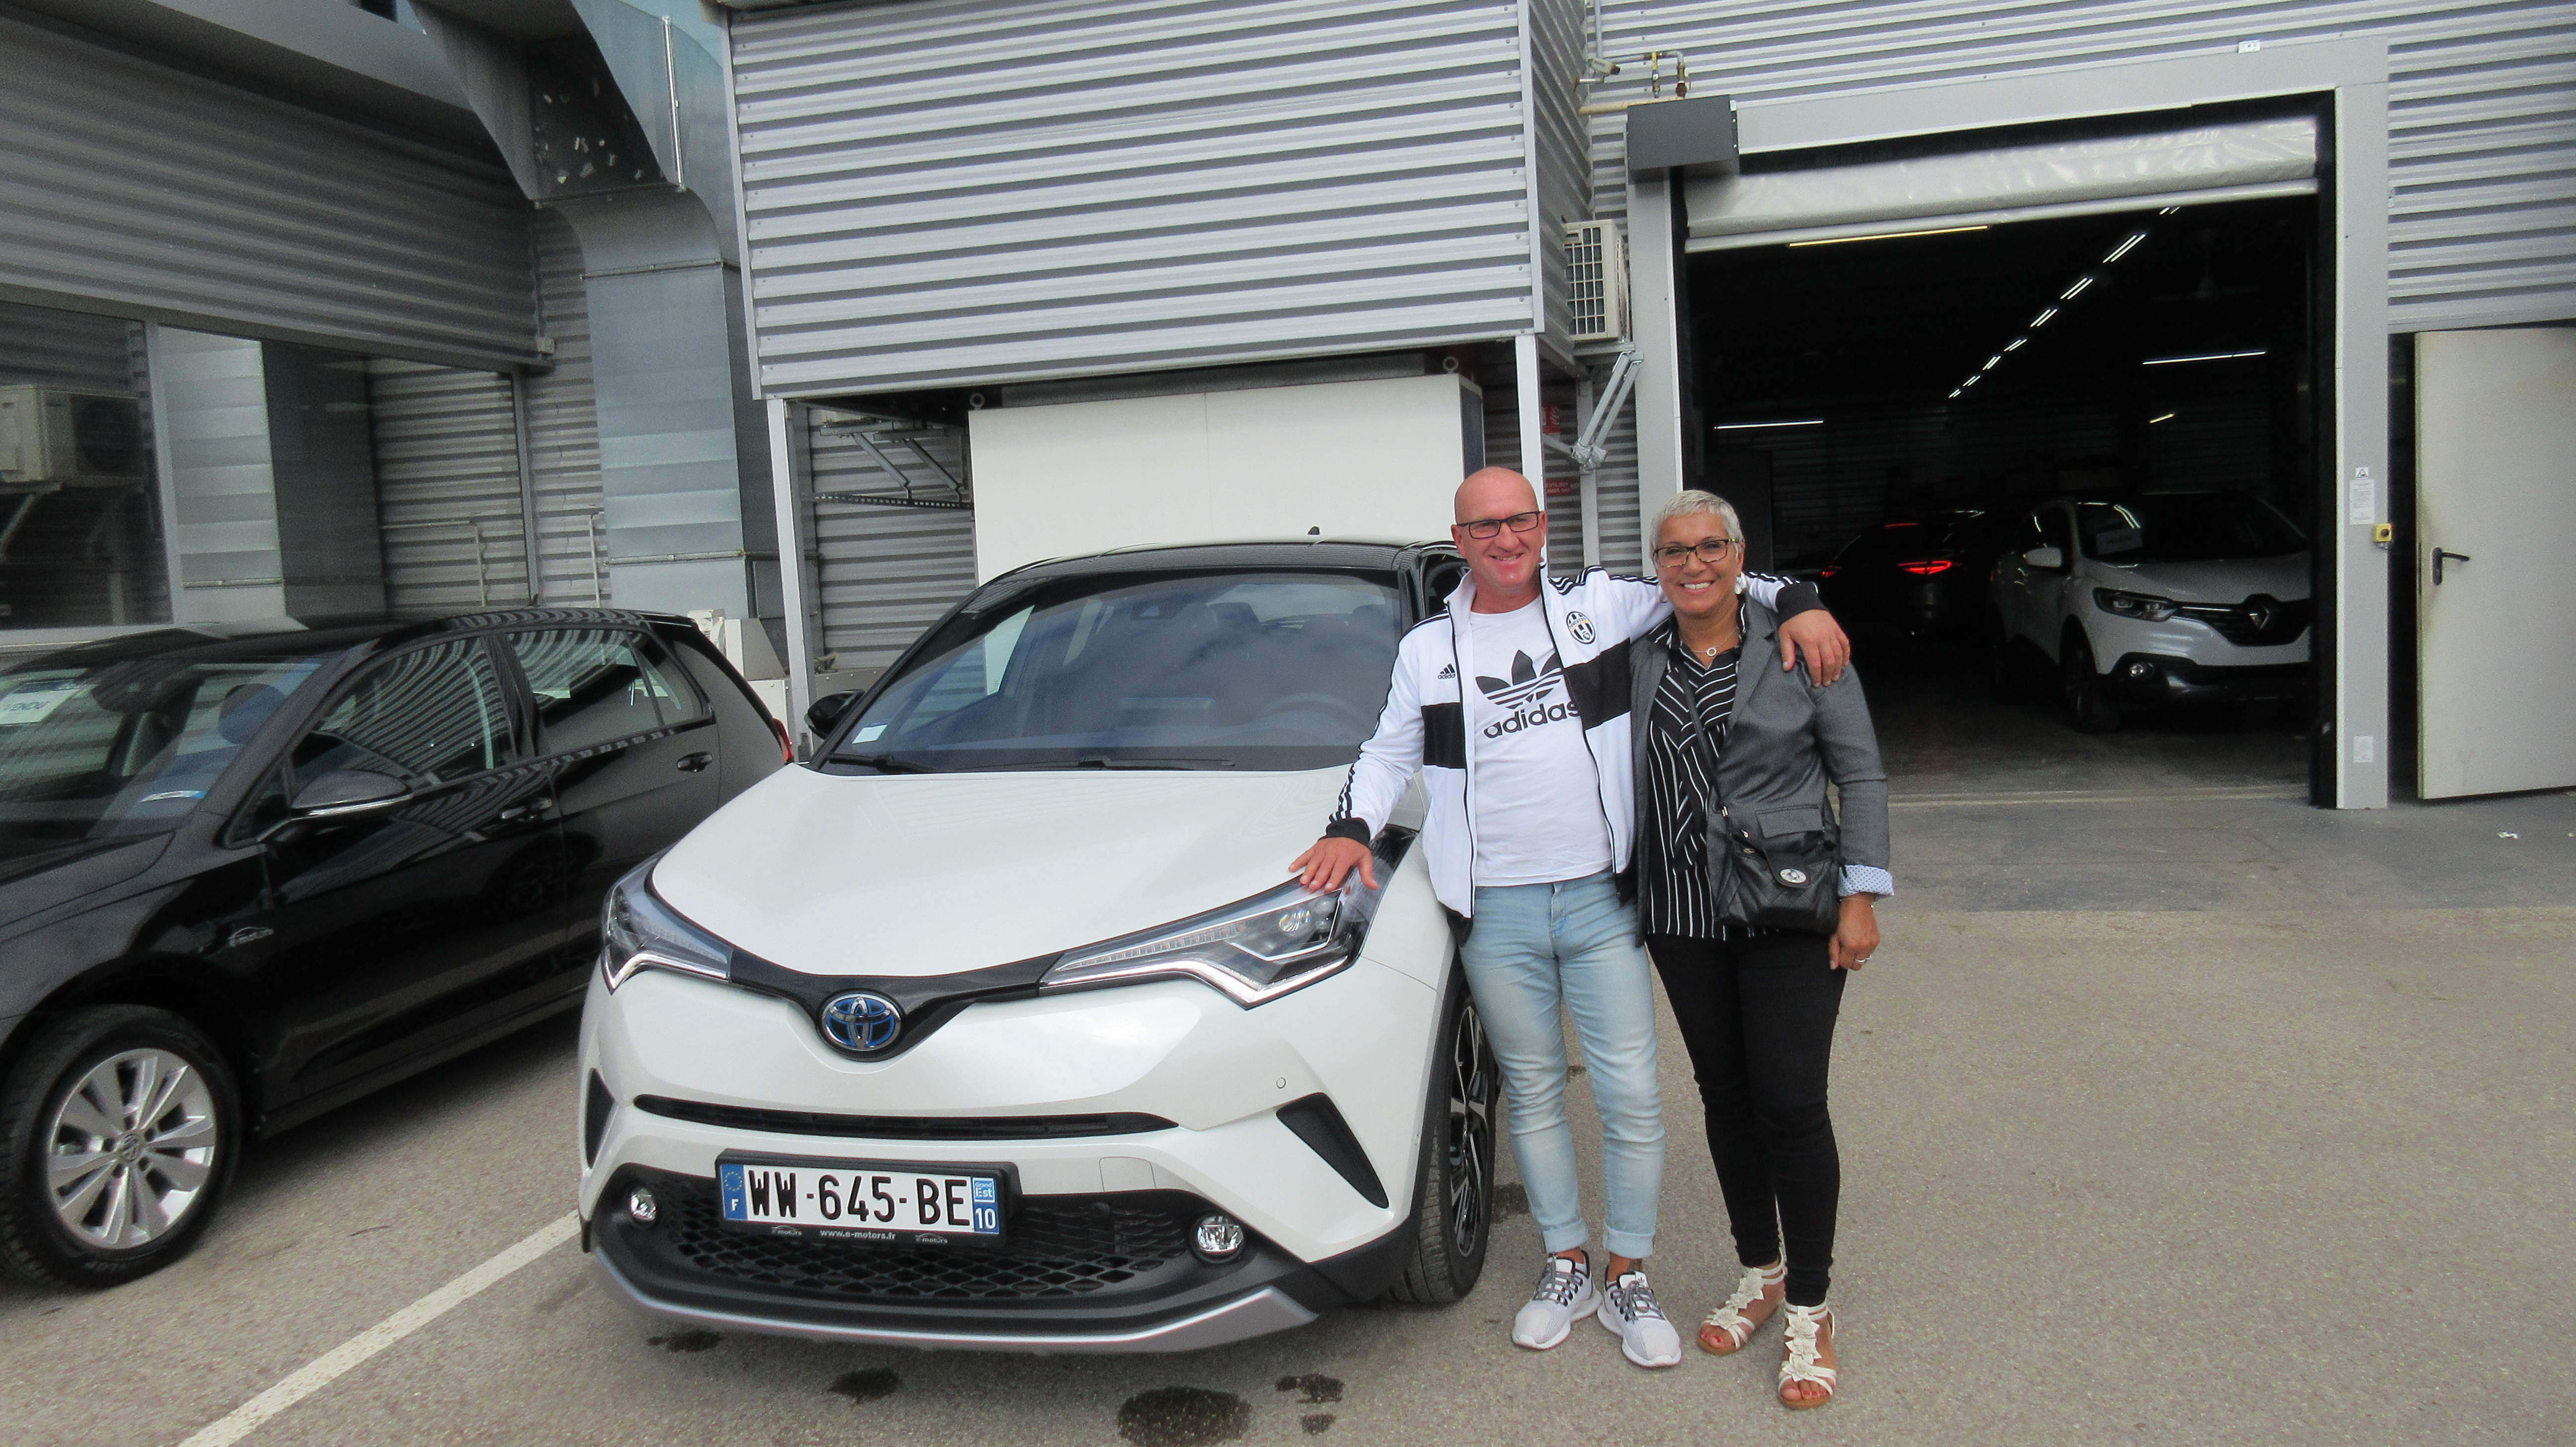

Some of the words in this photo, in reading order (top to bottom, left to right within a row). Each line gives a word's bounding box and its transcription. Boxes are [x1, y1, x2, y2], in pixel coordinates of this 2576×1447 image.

[1483, 701, 1580, 738] adidas
[975, 1187, 993, 1198] Est
[731, 1198, 739, 1211] F
[975, 1207, 996, 1229] 10
[819, 1229, 895, 1240] www.e-motors.fr
